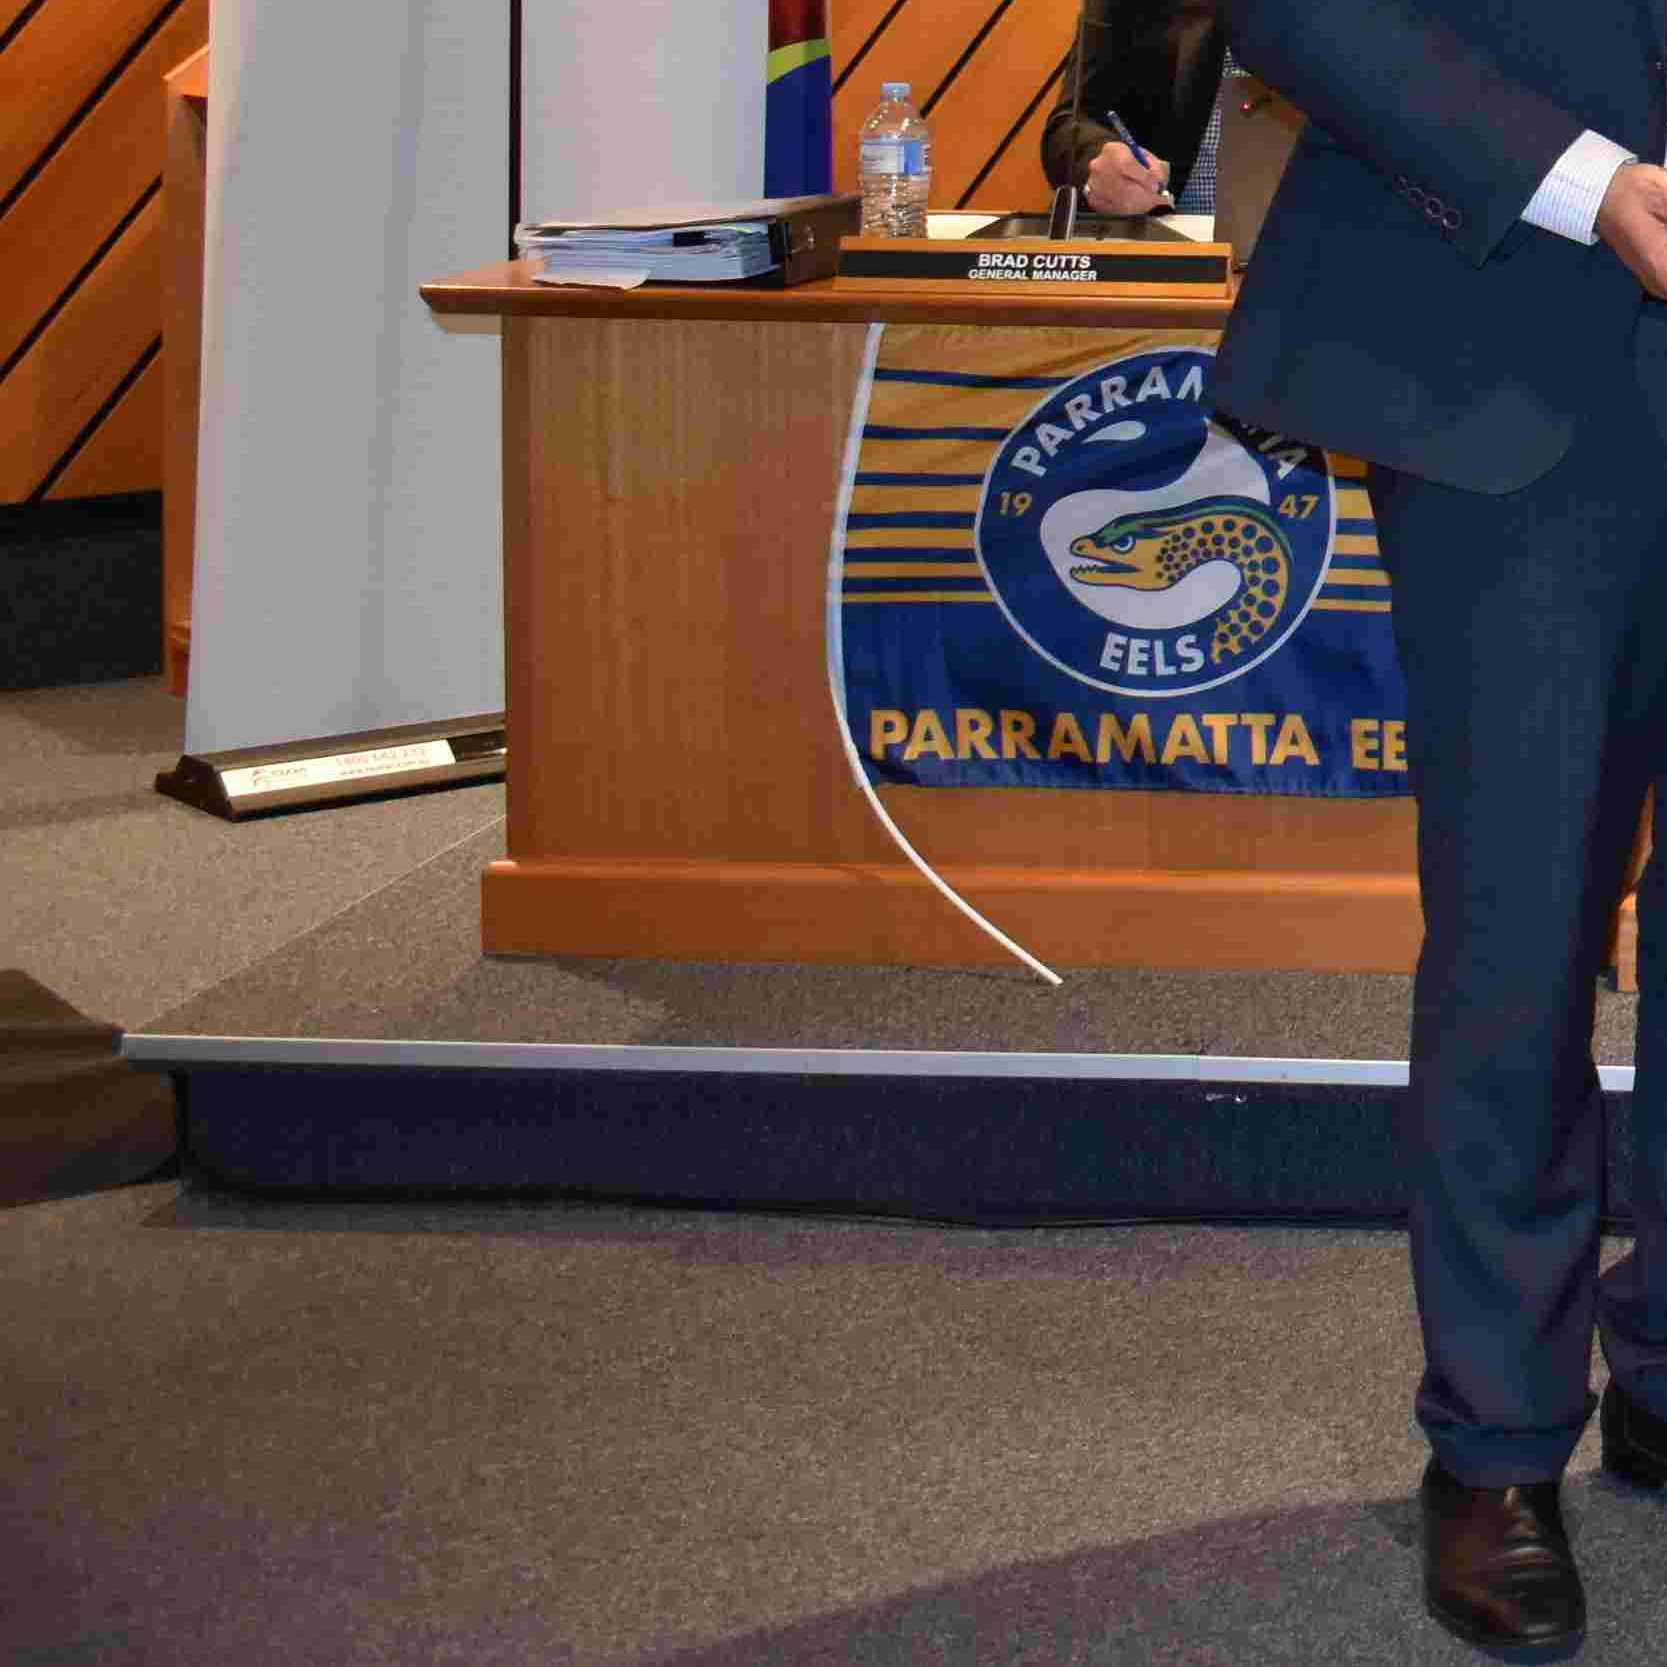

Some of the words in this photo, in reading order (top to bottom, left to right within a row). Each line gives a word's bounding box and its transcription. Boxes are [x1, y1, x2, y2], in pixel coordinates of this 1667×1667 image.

[968, 268, 1030, 280] GENERAL
[1032, 270, 1098, 281] MANAGER
[978, 253, 1030, 268] BRAD
[1033, 254, 1091, 269] CUTTS
[1000, 492, 1033, 517] 19
[1279, 493, 1320, 519] 47
[1099, 632, 1206, 677] EELS
[869, 708, 1321, 767] PARRAMATTA
[1351, 718, 1409, 772] EE
